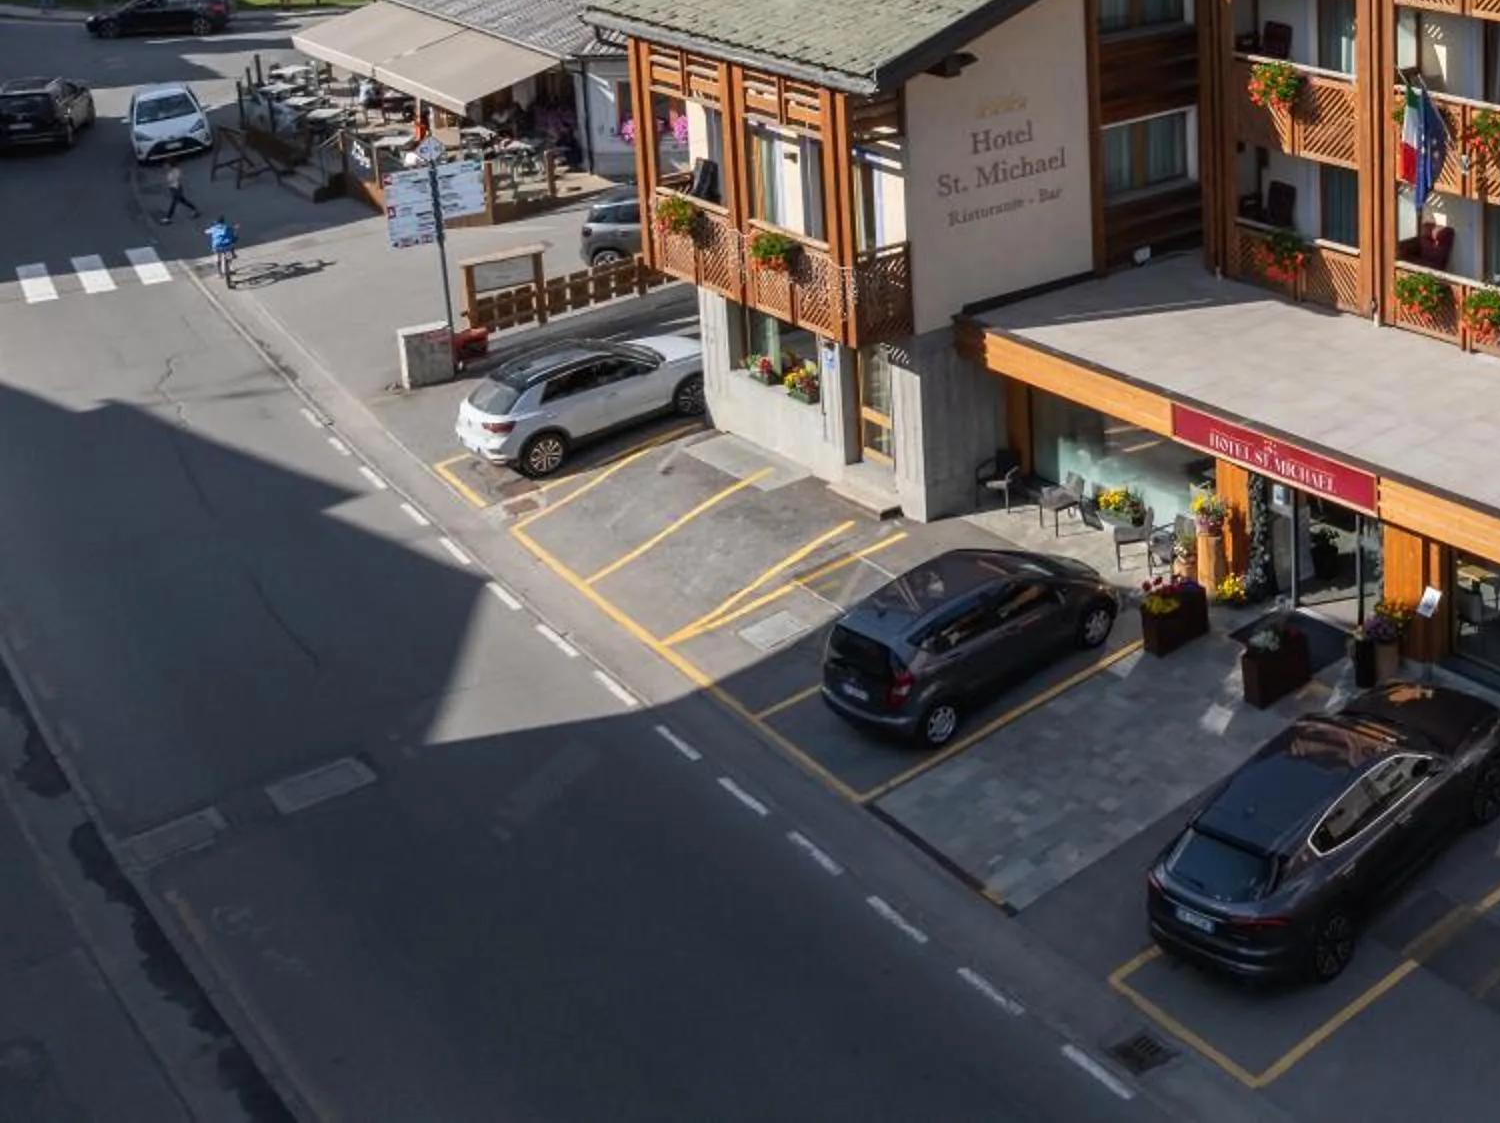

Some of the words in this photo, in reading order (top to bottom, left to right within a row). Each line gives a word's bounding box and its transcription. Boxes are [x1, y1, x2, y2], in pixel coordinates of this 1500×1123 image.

[970, 119, 1033, 155] Hotel
[936, 173, 969, 197] St.
[975, 145, 1067, 188] Michael
[1038, 187, 1063, 203] Bar
[1208, 431, 1251, 461] HOTEL
[1274, 459, 1337, 493] MICHAEL
